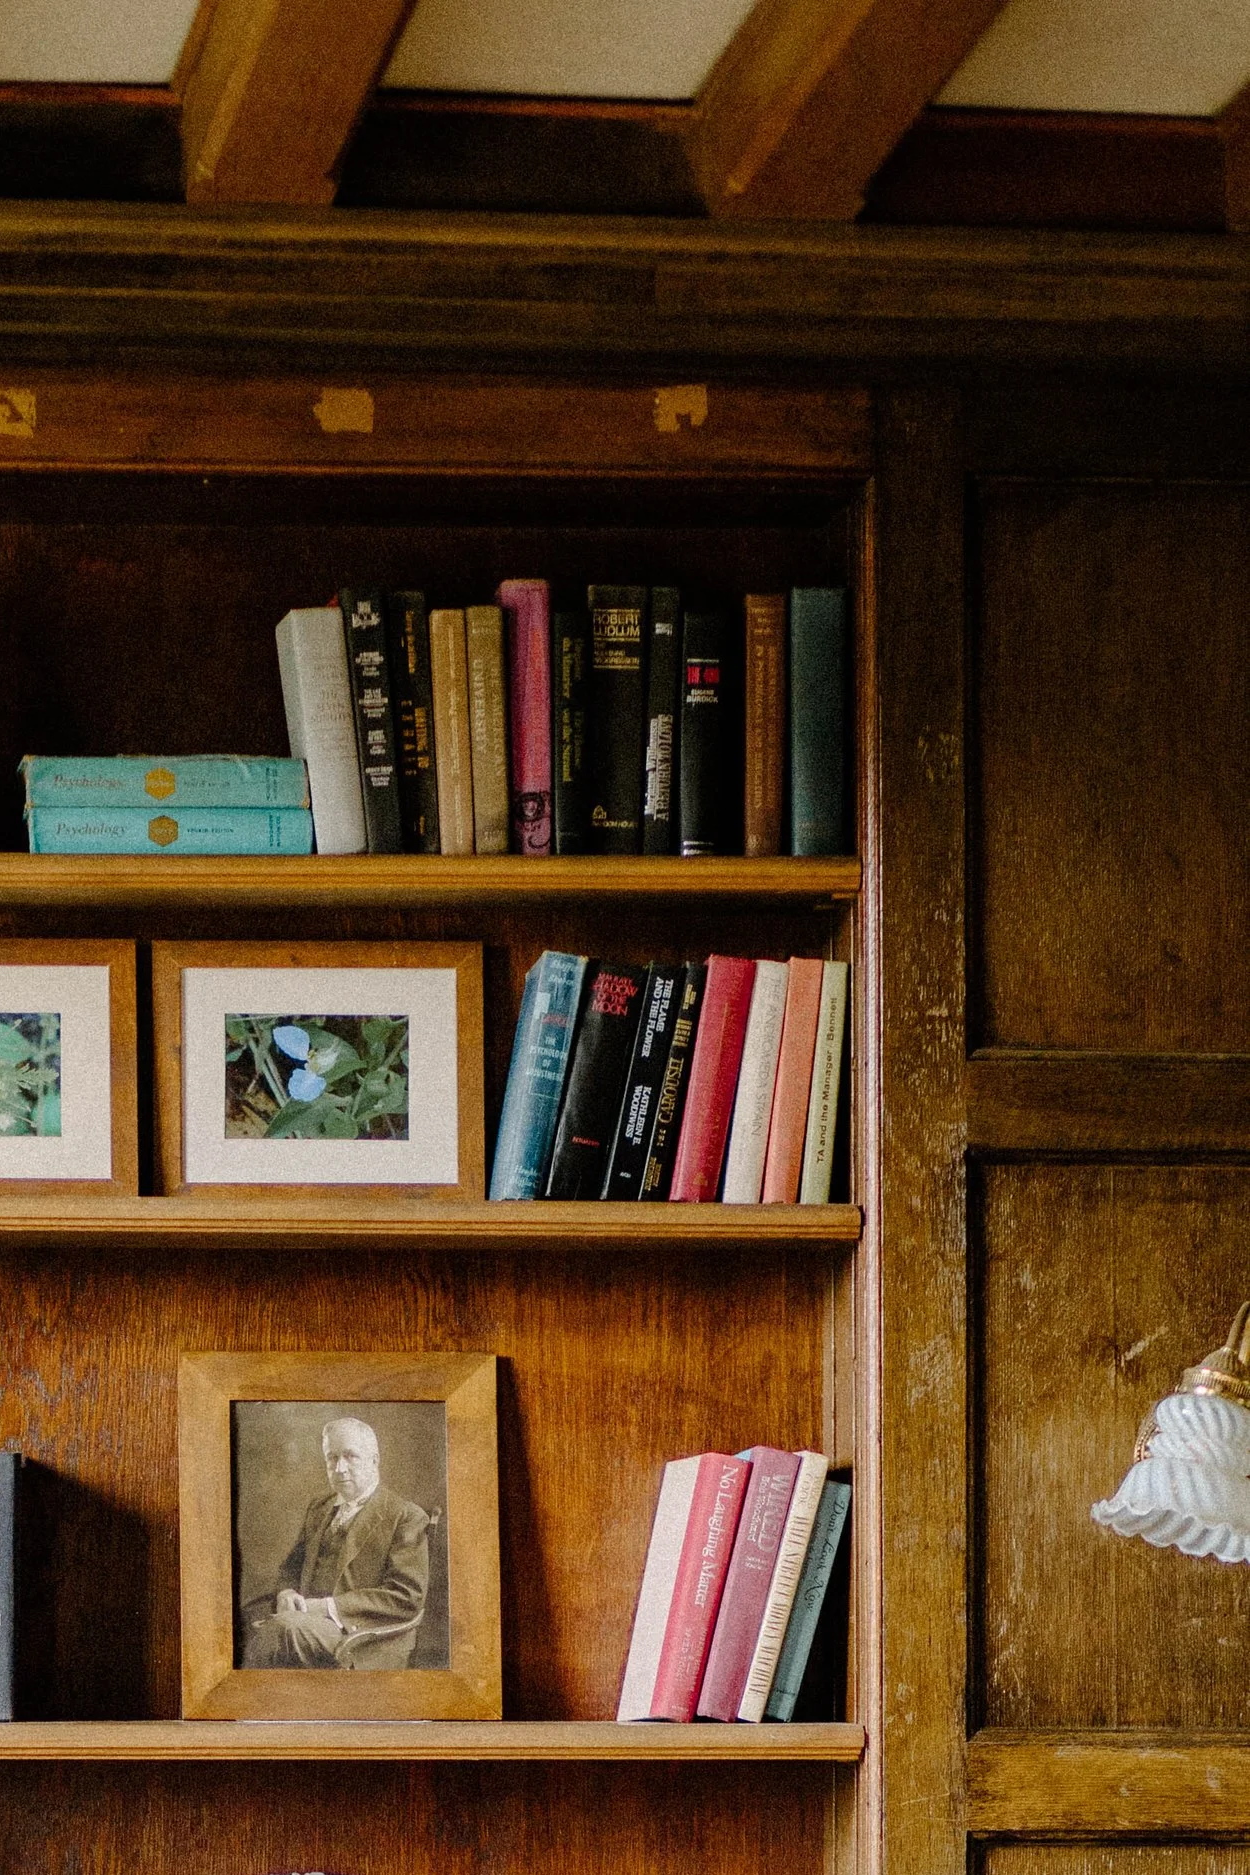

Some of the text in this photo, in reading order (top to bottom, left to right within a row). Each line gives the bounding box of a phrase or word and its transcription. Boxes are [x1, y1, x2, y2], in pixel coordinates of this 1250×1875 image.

[593, 612, 639, 626] ROBERT
[593, 625, 640, 638] LUDLUM
[473, 658, 488, 755] UNIVERSITY
[686, 695, 718, 704] BURDICK
[657, 714, 674, 742] LOVE
[654, 761, 671, 810] RETURN
[55, 822, 127, 837] Psychology
[591, 1001, 628, 1017] MOON
[640, 976, 663, 1058] AND THE FLOWER
[655, 978, 673, 1032] THE FLAME
[529, 1045, 566, 1060] PSYCHOLOGY
[750, 977, 780, 1136] THE ANDROMEDA STRAIN
[658, 1055, 685, 1124] CAROUSEL
[821, 1050, 833, 1100] Manager
[624, 1084, 643, 1138] WOODIWISS
[634, 1085, 651, 1136] KATHLEEN
[819, 1103, 828, 1121] the
[817, 1125, 826, 1145] and
[816, 1148, 824, 1163] TA
[722, 1464, 739, 1489] No
[701, 1490, 734, 1560] Laughing
[747, 1475, 771, 1543] Bob Woodward
[757, 1474, 791, 1551] WIRED
[825, 1499, 845, 1535] Don't
[814, 1537, 834, 1576] Look
[694, 1560, 716, 1608] Matter
[804, 1575, 825, 1613] Now
